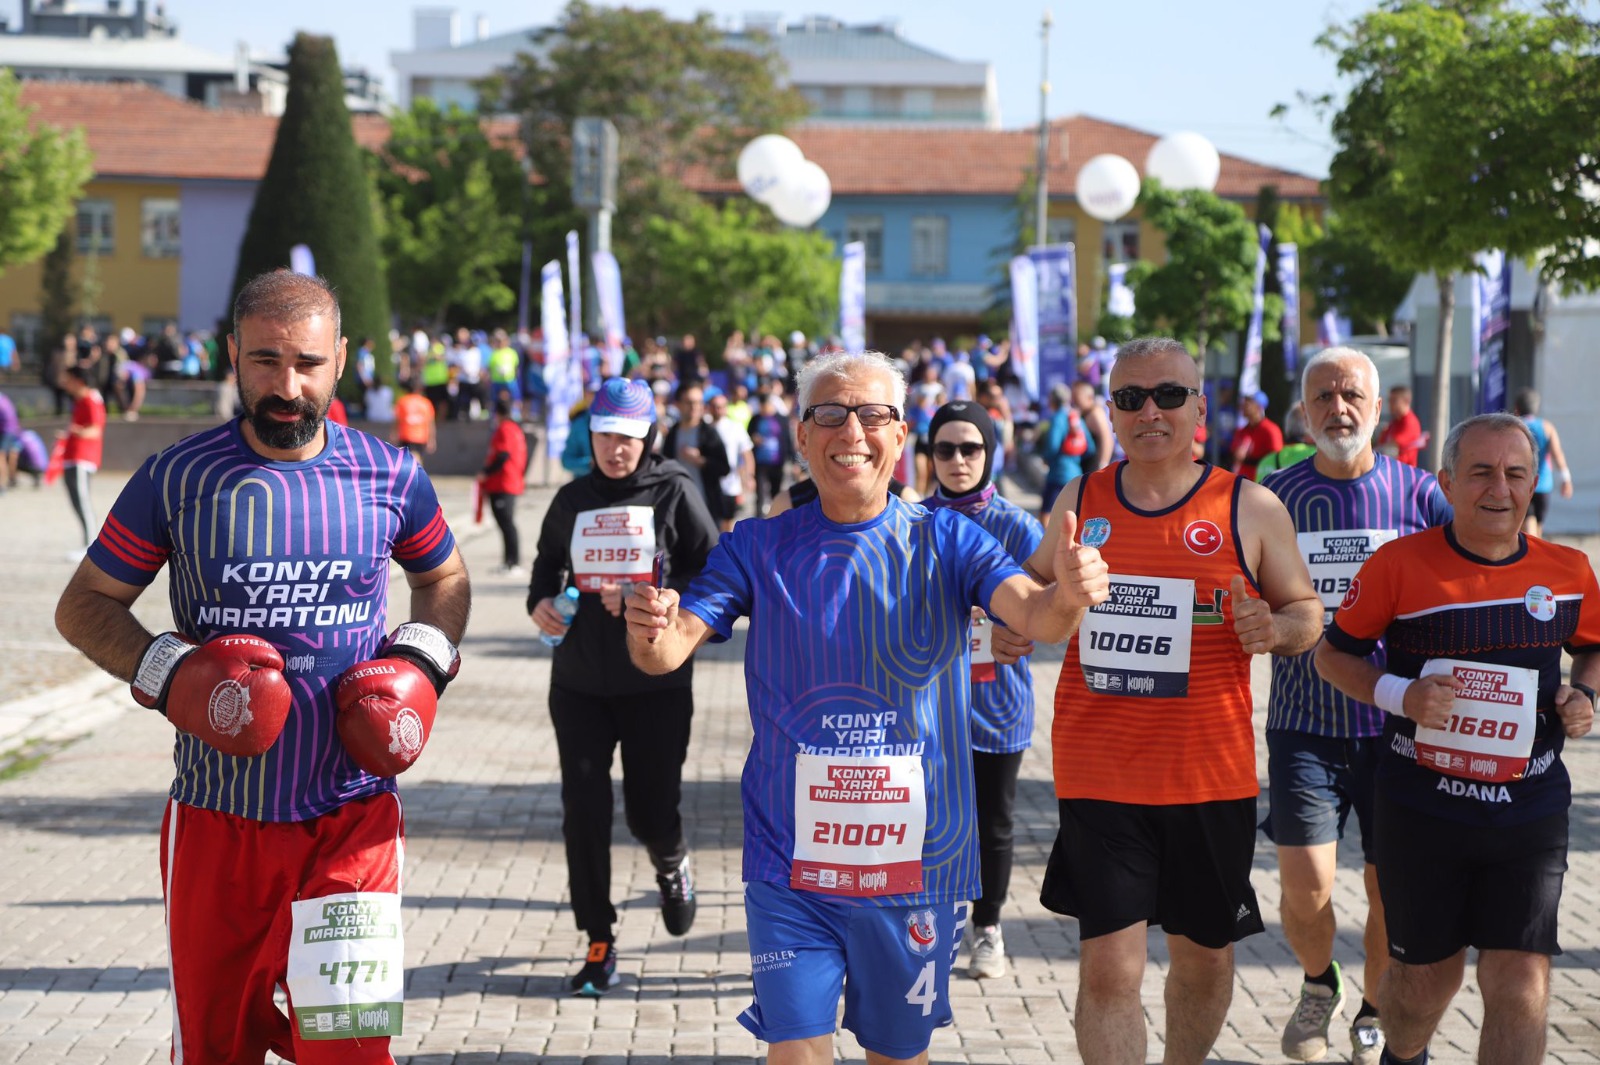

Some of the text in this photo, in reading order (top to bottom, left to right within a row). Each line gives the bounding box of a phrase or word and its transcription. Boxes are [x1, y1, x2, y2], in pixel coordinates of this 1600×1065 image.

[1327, 538, 1366, 547] KONYA
[584, 548, 641, 562] 21395
[1313, 553, 1373, 563] MARATON
[222, 560, 352, 584] KONYA
[1110, 585, 1156, 597] KONYA
[1313, 578, 1351, 593] 103
[243, 583, 330, 604] YARI
[1116, 595, 1148, 606] YARI
[197, 601, 371, 629] MARATONU
[1094, 603, 1172, 617] MARATONU
[1090, 631, 1172, 656] 10066
[1457, 670, 1504, 683] KONYA
[1464, 679, 1496, 691] YARI
[1454, 688, 1519, 703] ARATONU
[822, 711, 897, 729] KONYA
[1441, 714, 1519, 740] 1680
[835, 728, 887, 745] YARI
[832, 769, 887, 779] KONYA
[840, 779, 877, 790] YARI
[1437, 777, 1513, 803] ADANA
[815, 788, 905, 801] MARATONU
[813, 821, 907, 846] 21004
[326, 903, 380, 916] KONYA
[335, 915, 373, 926] YARI
[905, 960, 938, 1017] 4
